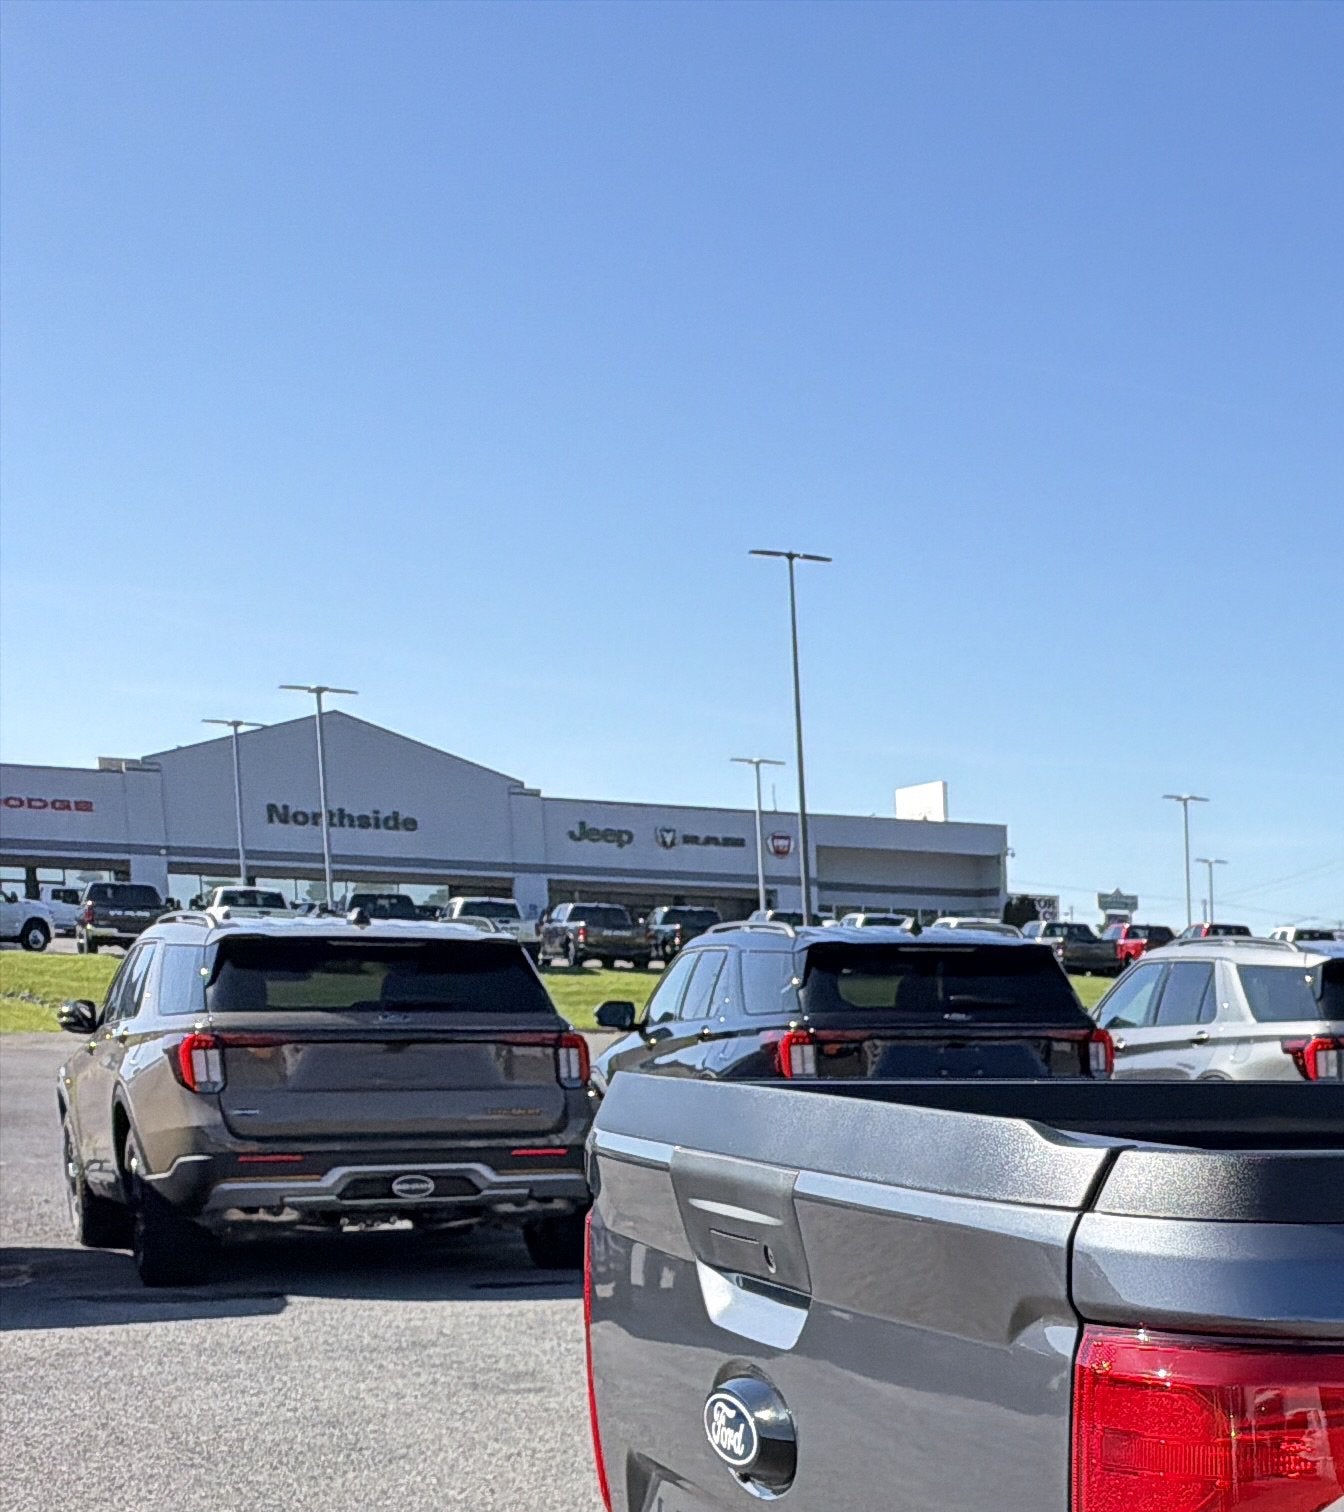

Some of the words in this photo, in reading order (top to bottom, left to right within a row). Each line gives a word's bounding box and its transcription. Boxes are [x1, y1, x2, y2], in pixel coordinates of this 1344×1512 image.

[0, 796, 94, 812] ODGE
[266, 803, 418, 831] Northside
[567, 821, 634, 848] Jeep
[709, 1399, 747, 1458] Ford
